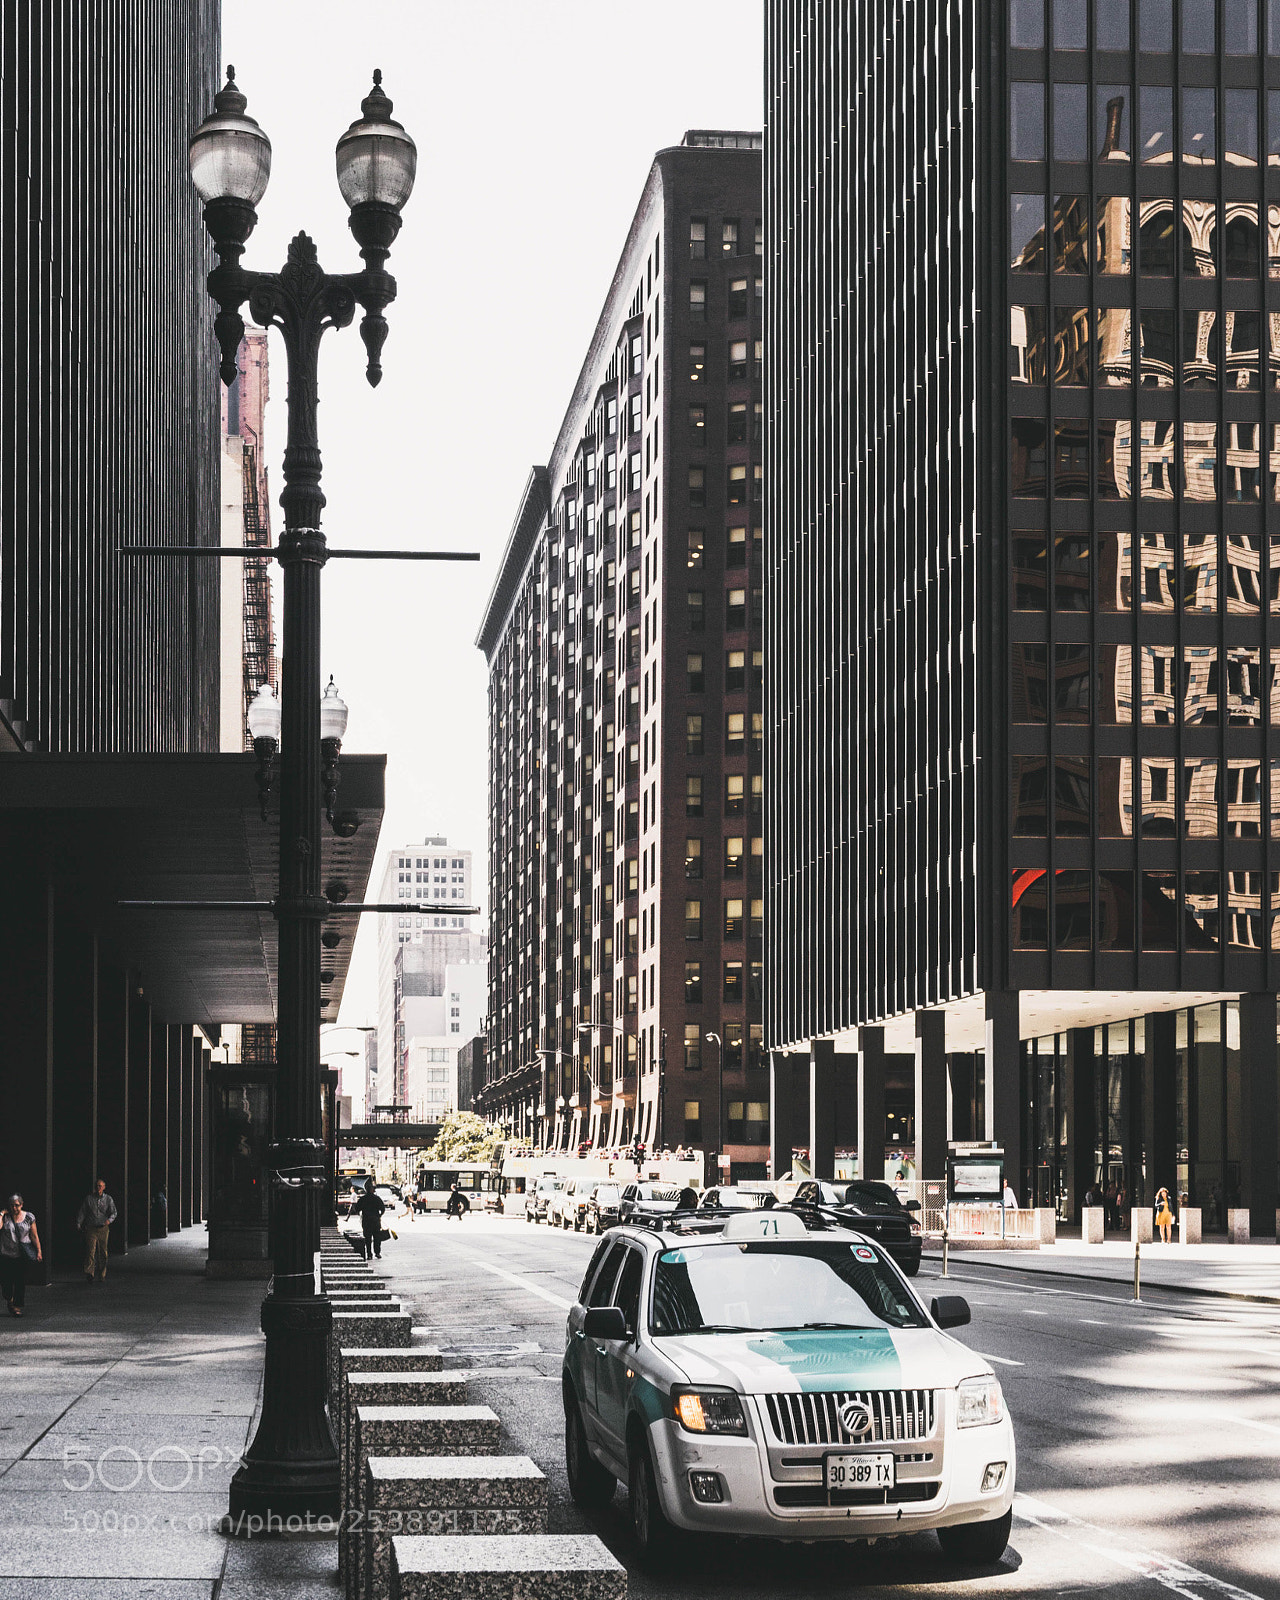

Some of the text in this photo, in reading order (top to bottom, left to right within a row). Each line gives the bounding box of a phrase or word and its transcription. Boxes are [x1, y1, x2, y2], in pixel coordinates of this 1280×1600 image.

[760, 1219, 780, 1236] 71
[830, 1464, 890, 1482] 30 389 TX
